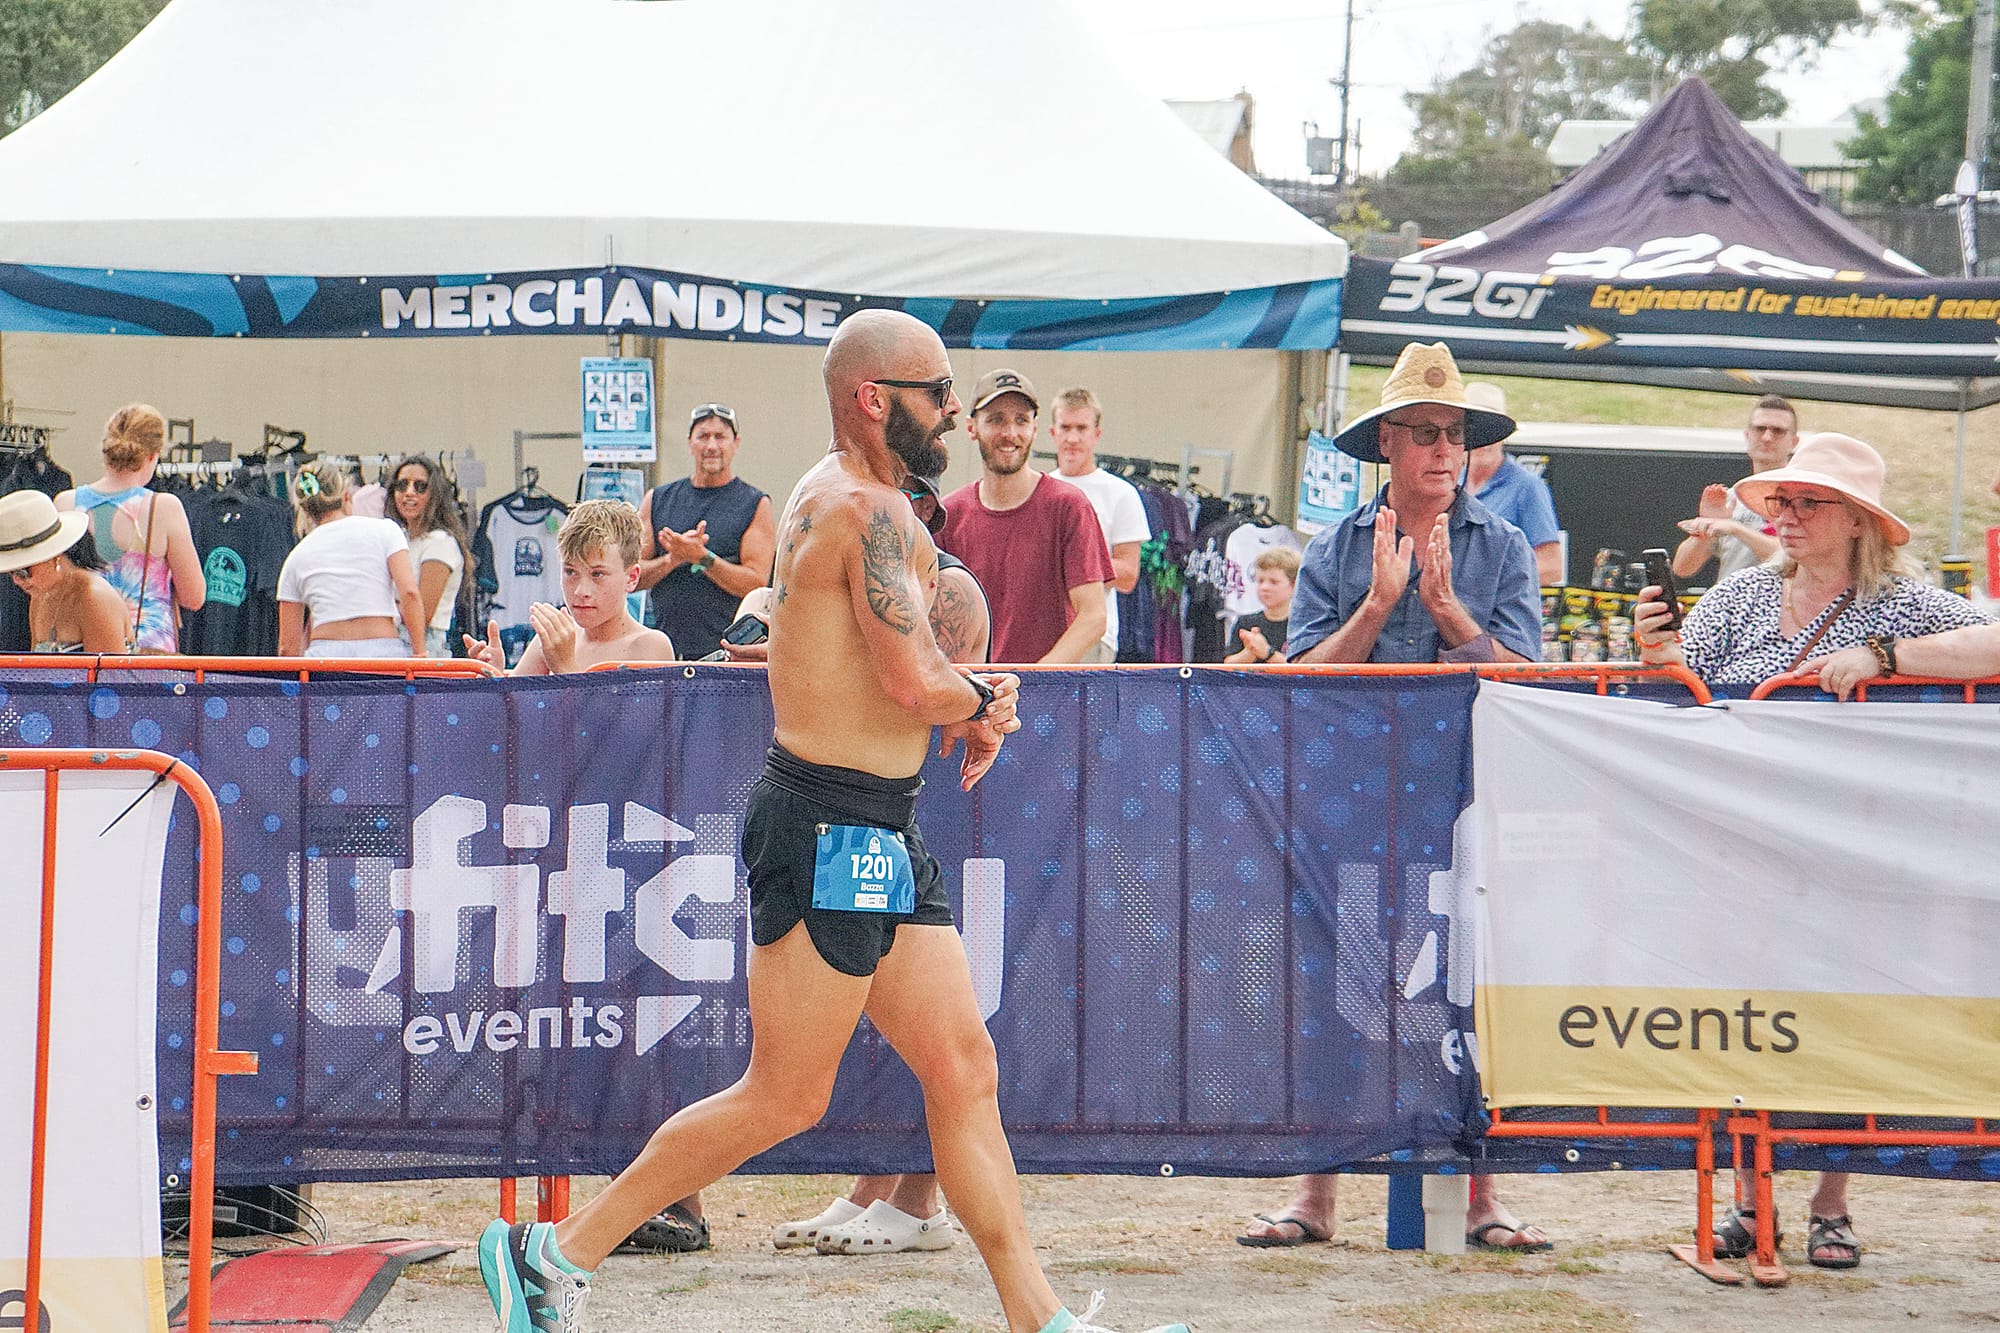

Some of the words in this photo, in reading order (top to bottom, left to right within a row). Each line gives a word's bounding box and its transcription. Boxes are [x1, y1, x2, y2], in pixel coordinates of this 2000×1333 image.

[381, 277, 843, 338] MERCHANDISE
[1590, 284, 1748, 316] Engineered
[1746, 287, 1793, 315] for
[1794, 293, 1938, 320] sustained
[1936, 298, 2000, 325] ener
[850, 854, 894, 881] 1201
[403, 997, 624, 1055] events
[1559, 997, 1800, 1053] events
